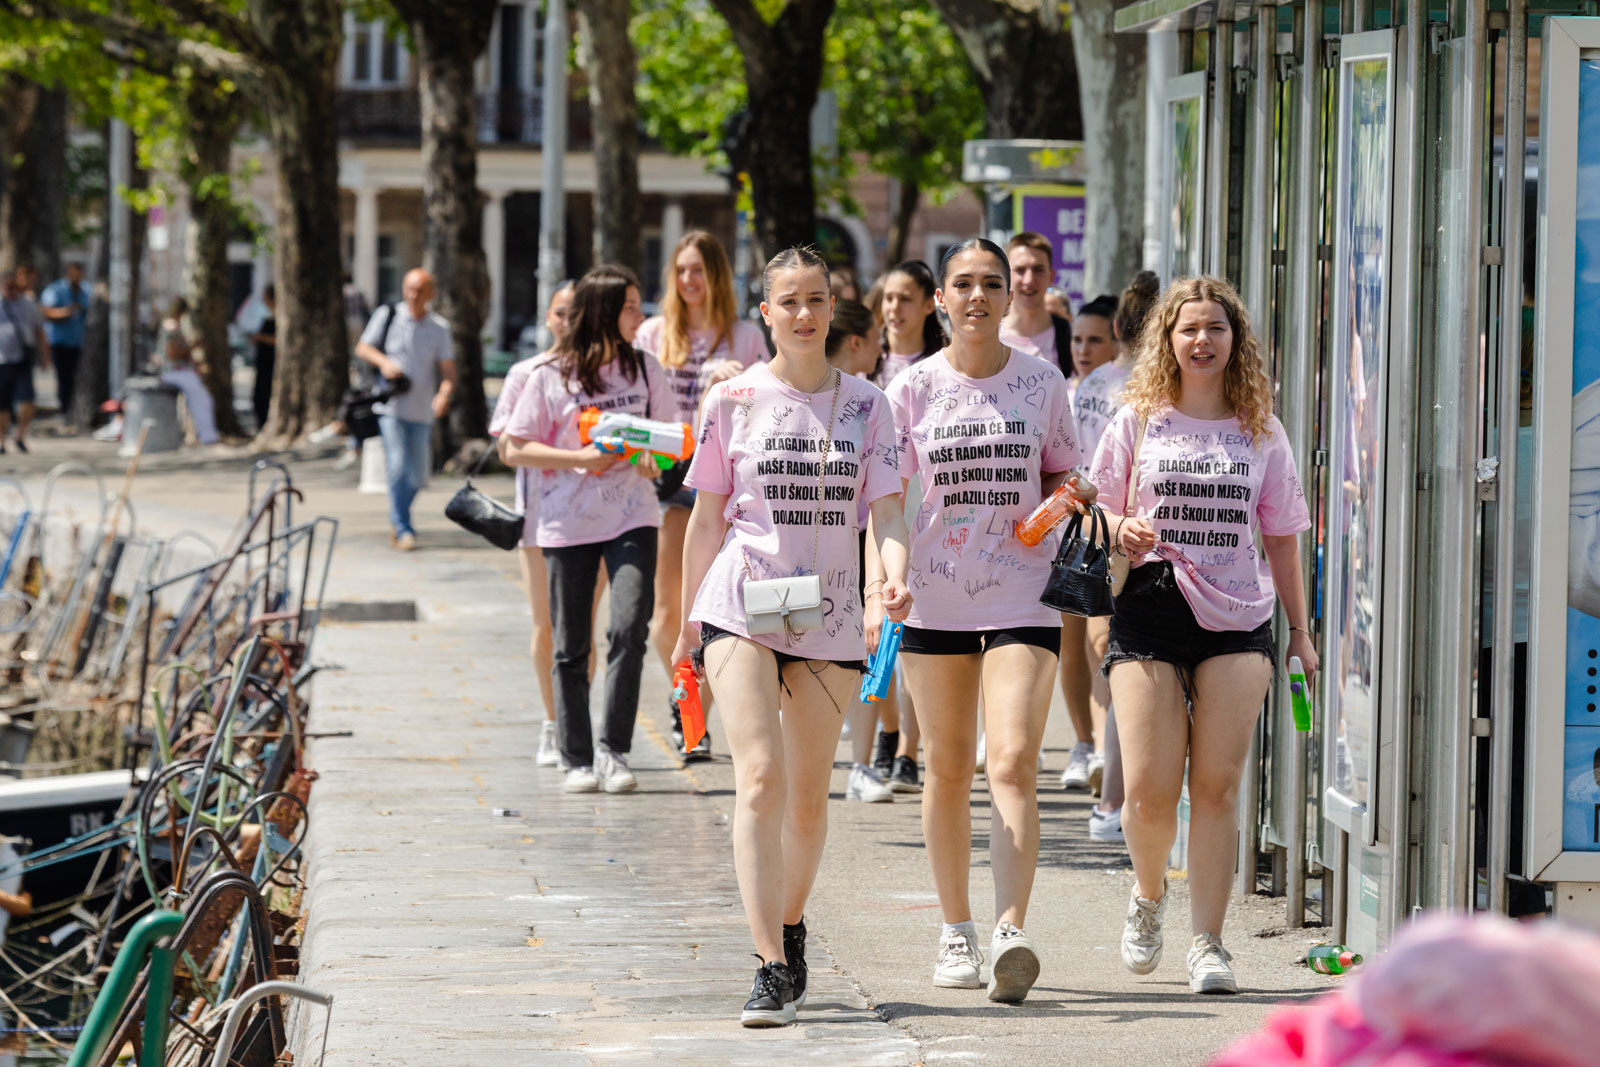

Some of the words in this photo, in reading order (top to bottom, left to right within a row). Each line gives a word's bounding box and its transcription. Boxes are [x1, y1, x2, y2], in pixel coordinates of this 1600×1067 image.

[1057, 209, 1084, 235] BE
[966, 394, 998, 406] LEON
[934, 423, 986, 440] BLAGAJNA
[989, 421, 1002, 435] ĆE
[1005, 421, 1025, 435] BITI
[1216, 431, 1253, 448] LEON
[765, 437, 817, 453] BLAGAJNA
[834, 440, 855, 454] BITI
[928, 446, 953, 465] NAŠE
[956, 445, 992, 461] RADNO
[994, 444, 1031, 459] MJESTO
[757, 457, 785, 476] NAŠE
[786, 460, 820, 477] RADNO
[824, 461, 859, 479] MJESTO
[934, 473, 950, 486] JER
[952, 470, 960, 484] U
[961, 467, 993, 483] ŠKOLU
[995, 468, 1028, 482] NISMO
[1159, 459, 1211, 475] BLAGAJNA
[1214, 461, 1227, 475] ĆE
[1229, 462, 1249, 476] BITI
[780, 485, 787, 500] U
[788, 482, 820, 501] ŠKOLU
[824, 486, 855, 501] NISMO
[944, 491, 986, 508] DOLAZILI
[988, 490, 1020, 506] ČESTO
[1153, 481, 1177, 497] NAŠE
[1179, 482, 1214, 499] RADNO
[1217, 484, 1251, 500] MJESTO
[1153, 505, 1170, 520] JER
[1172, 506, 1180, 520] U
[1181, 504, 1214, 522] ŠKOLU
[1216, 510, 1248, 525] NISMO
[1160, 528, 1206, 546] DOLAZILI
[1207, 530, 1239, 548] ČESTO
